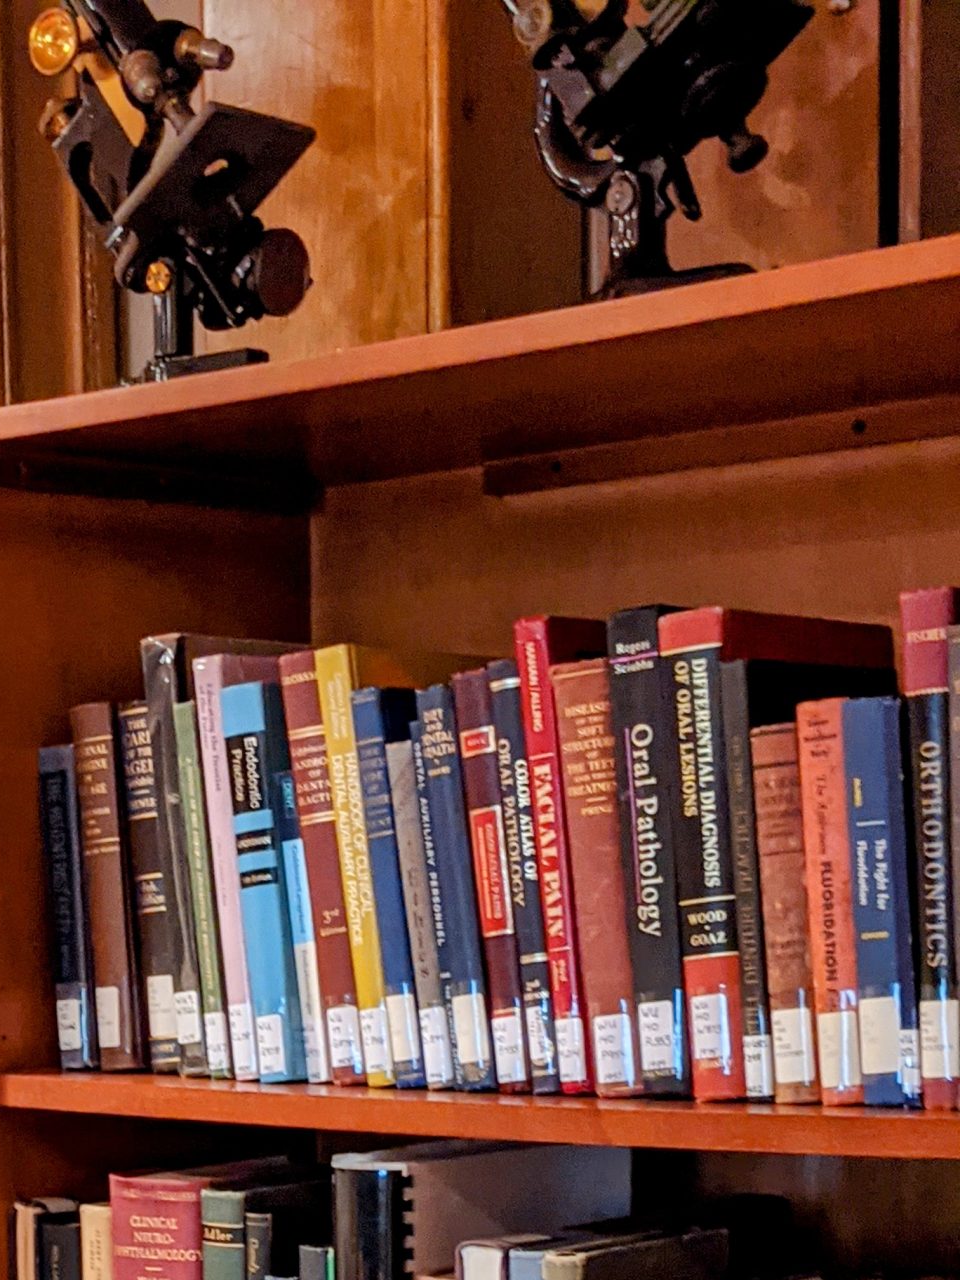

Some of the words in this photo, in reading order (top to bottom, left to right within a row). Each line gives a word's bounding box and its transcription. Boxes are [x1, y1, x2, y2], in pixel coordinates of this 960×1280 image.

[674, 661, 690, 684] OF
[677, 690, 694, 740] ORAL
[691, 658, 715, 788] DIFFERENTIAL
[231, 748, 245, 802] Practice
[243, 737, 261, 810] Endodontic
[331, 755, 348, 808] DENTAL
[497, 739, 514, 791] ORAL
[514, 760, 531, 808] COLOR
[631, 723, 658, 785] Oral
[680, 743, 699, 818] LESIONS
[345, 752, 364, 831] HANDBOOK
[534, 764, 560, 866] FACIAL
[338, 810, 357, 878] AUXILIARY
[353, 833, 366, 852] OF
[503, 797, 525, 907] PATHOLOGY
[519, 813, 536, 856] ATLAS
[636, 796, 665, 938] Pathology
[700, 791, 722, 888] DIAGNOSIS
[873, 839, 887, 860] The
[920, 740, 947, 968] ORTHODONTICS
[356, 854, 373, 918] CLINICAL
[419, 797, 435, 866] AUXILIARY
[429, 872, 445, 947] PERSONNEL
[524, 861, 538, 881] OF
[855, 839, 869, 906] Fluoridation
[873, 862, 888, 890] Fight
[875, 893, 888, 911] for
[346, 880, 364, 946] PRACTICE
[543, 871, 565, 940] PAIN
[819, 860, 838, 982] FLUORIDATION
[130, 1215, 178, 1229] CLINICAL
